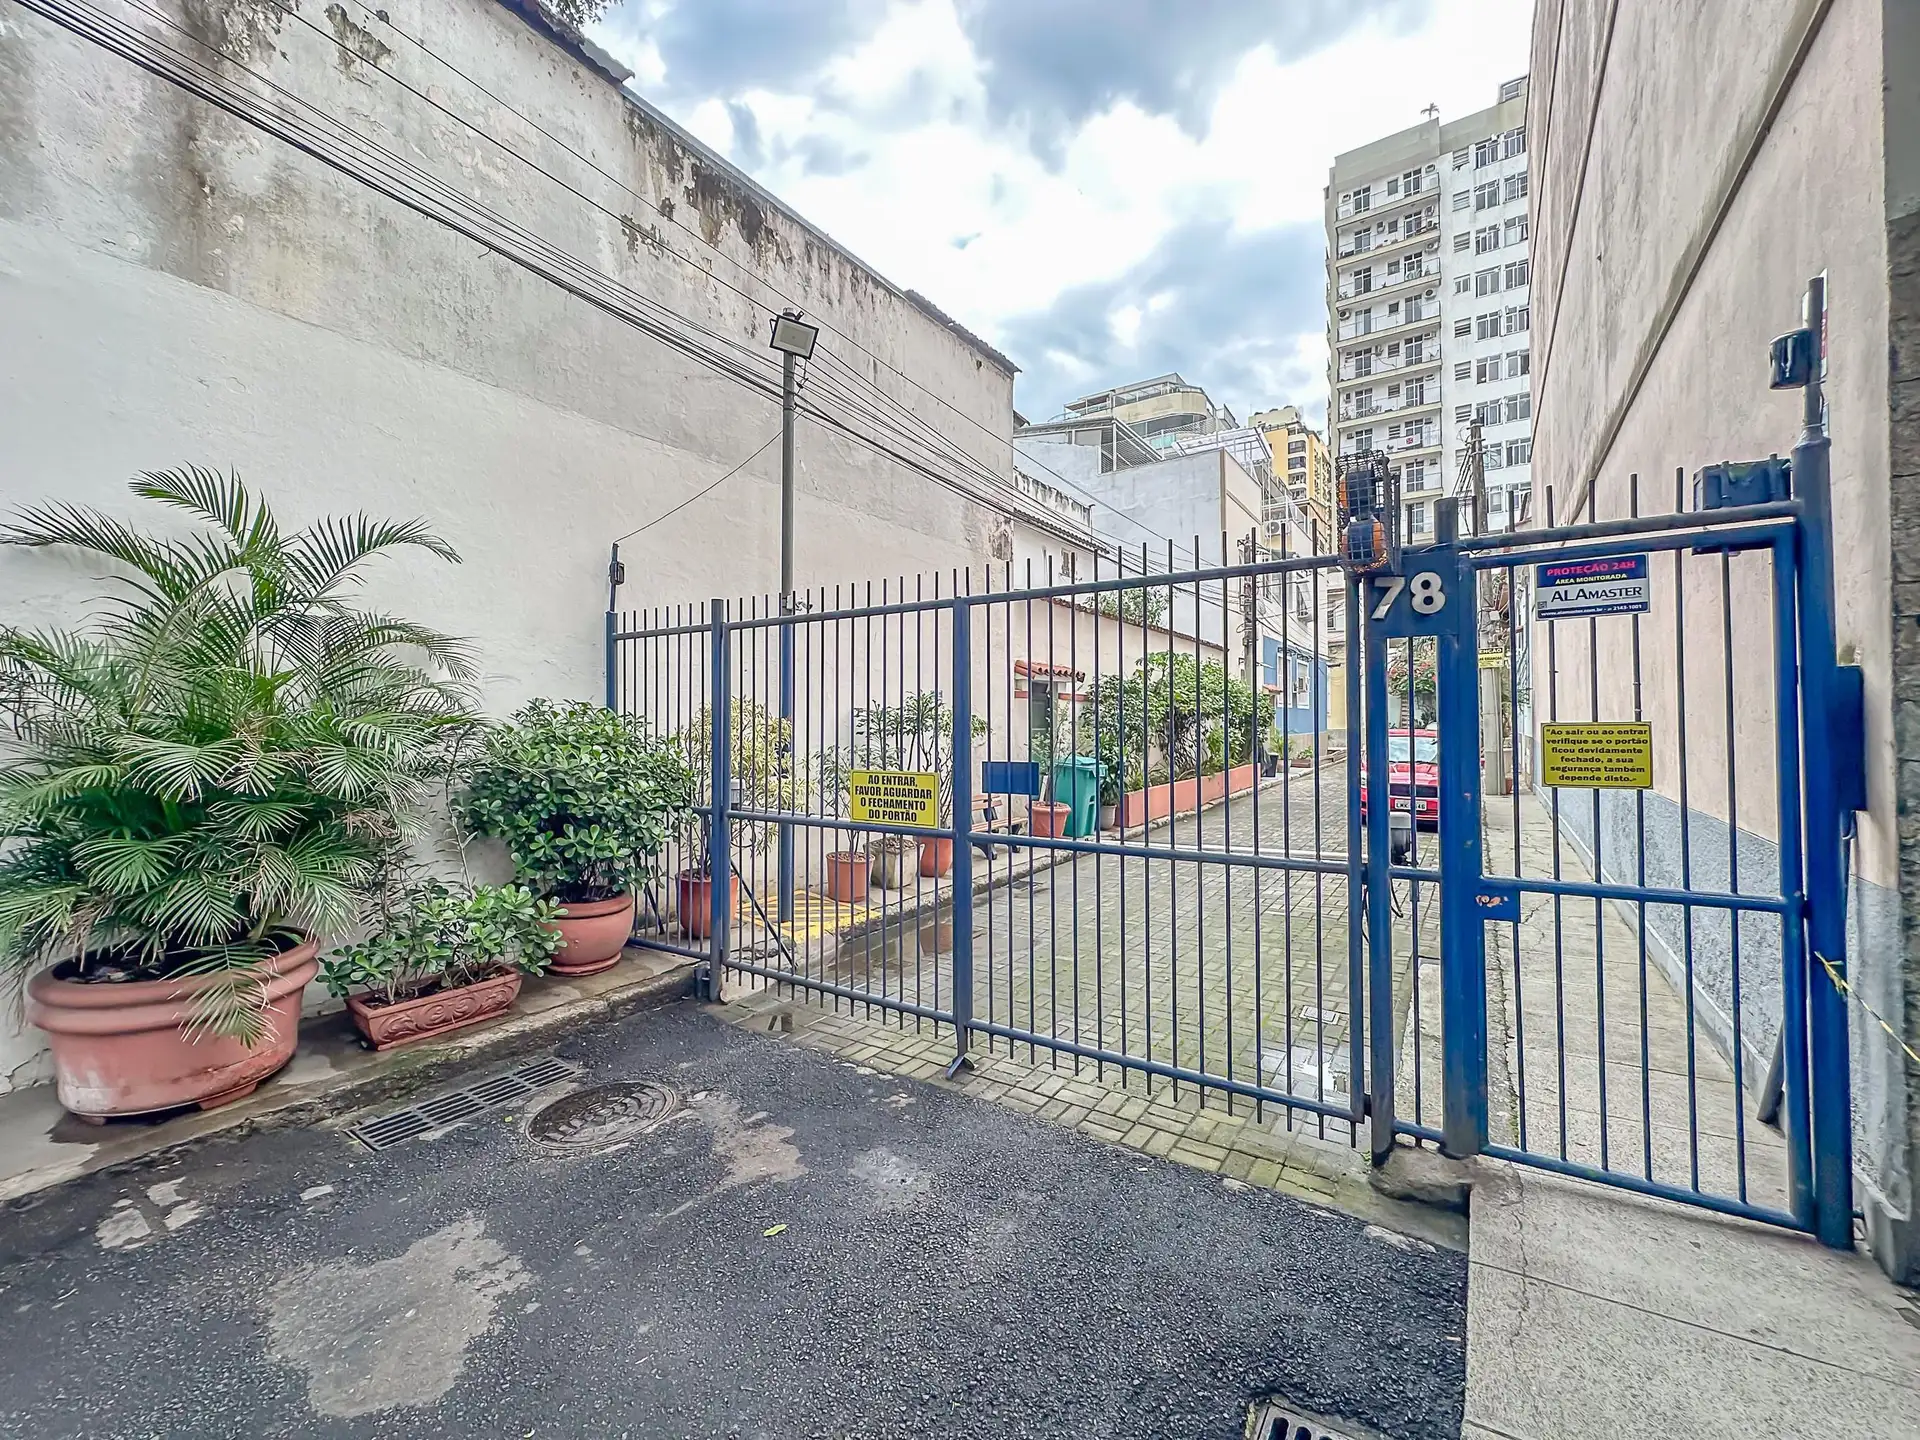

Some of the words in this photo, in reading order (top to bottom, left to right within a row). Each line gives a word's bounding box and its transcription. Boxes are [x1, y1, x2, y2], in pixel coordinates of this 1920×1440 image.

[1547, 563, 1609, 577] PROTEÇÃO
[1612, 560, 1636, 570] 24H
[1576, 573, 1627, 582] MONITORADA
[1370, 571, 1446, 620] 78
[1615, 738, 1648, 746] portão
[1604, 765, 1645, 773] também
[868, 774, 880, 785] AO
[881, 775, 918, 787] ENTRAR,
[855, 785, 882, 797] FAVOR
[883, 787, 932, 800] AGUARDAR
[860, 797, 866, 807] O
[868, 797, 926, 811] FECHAMENTO
[868, 809, 880, 820] DO
[882, 810, 917, 822] PORTÃO
